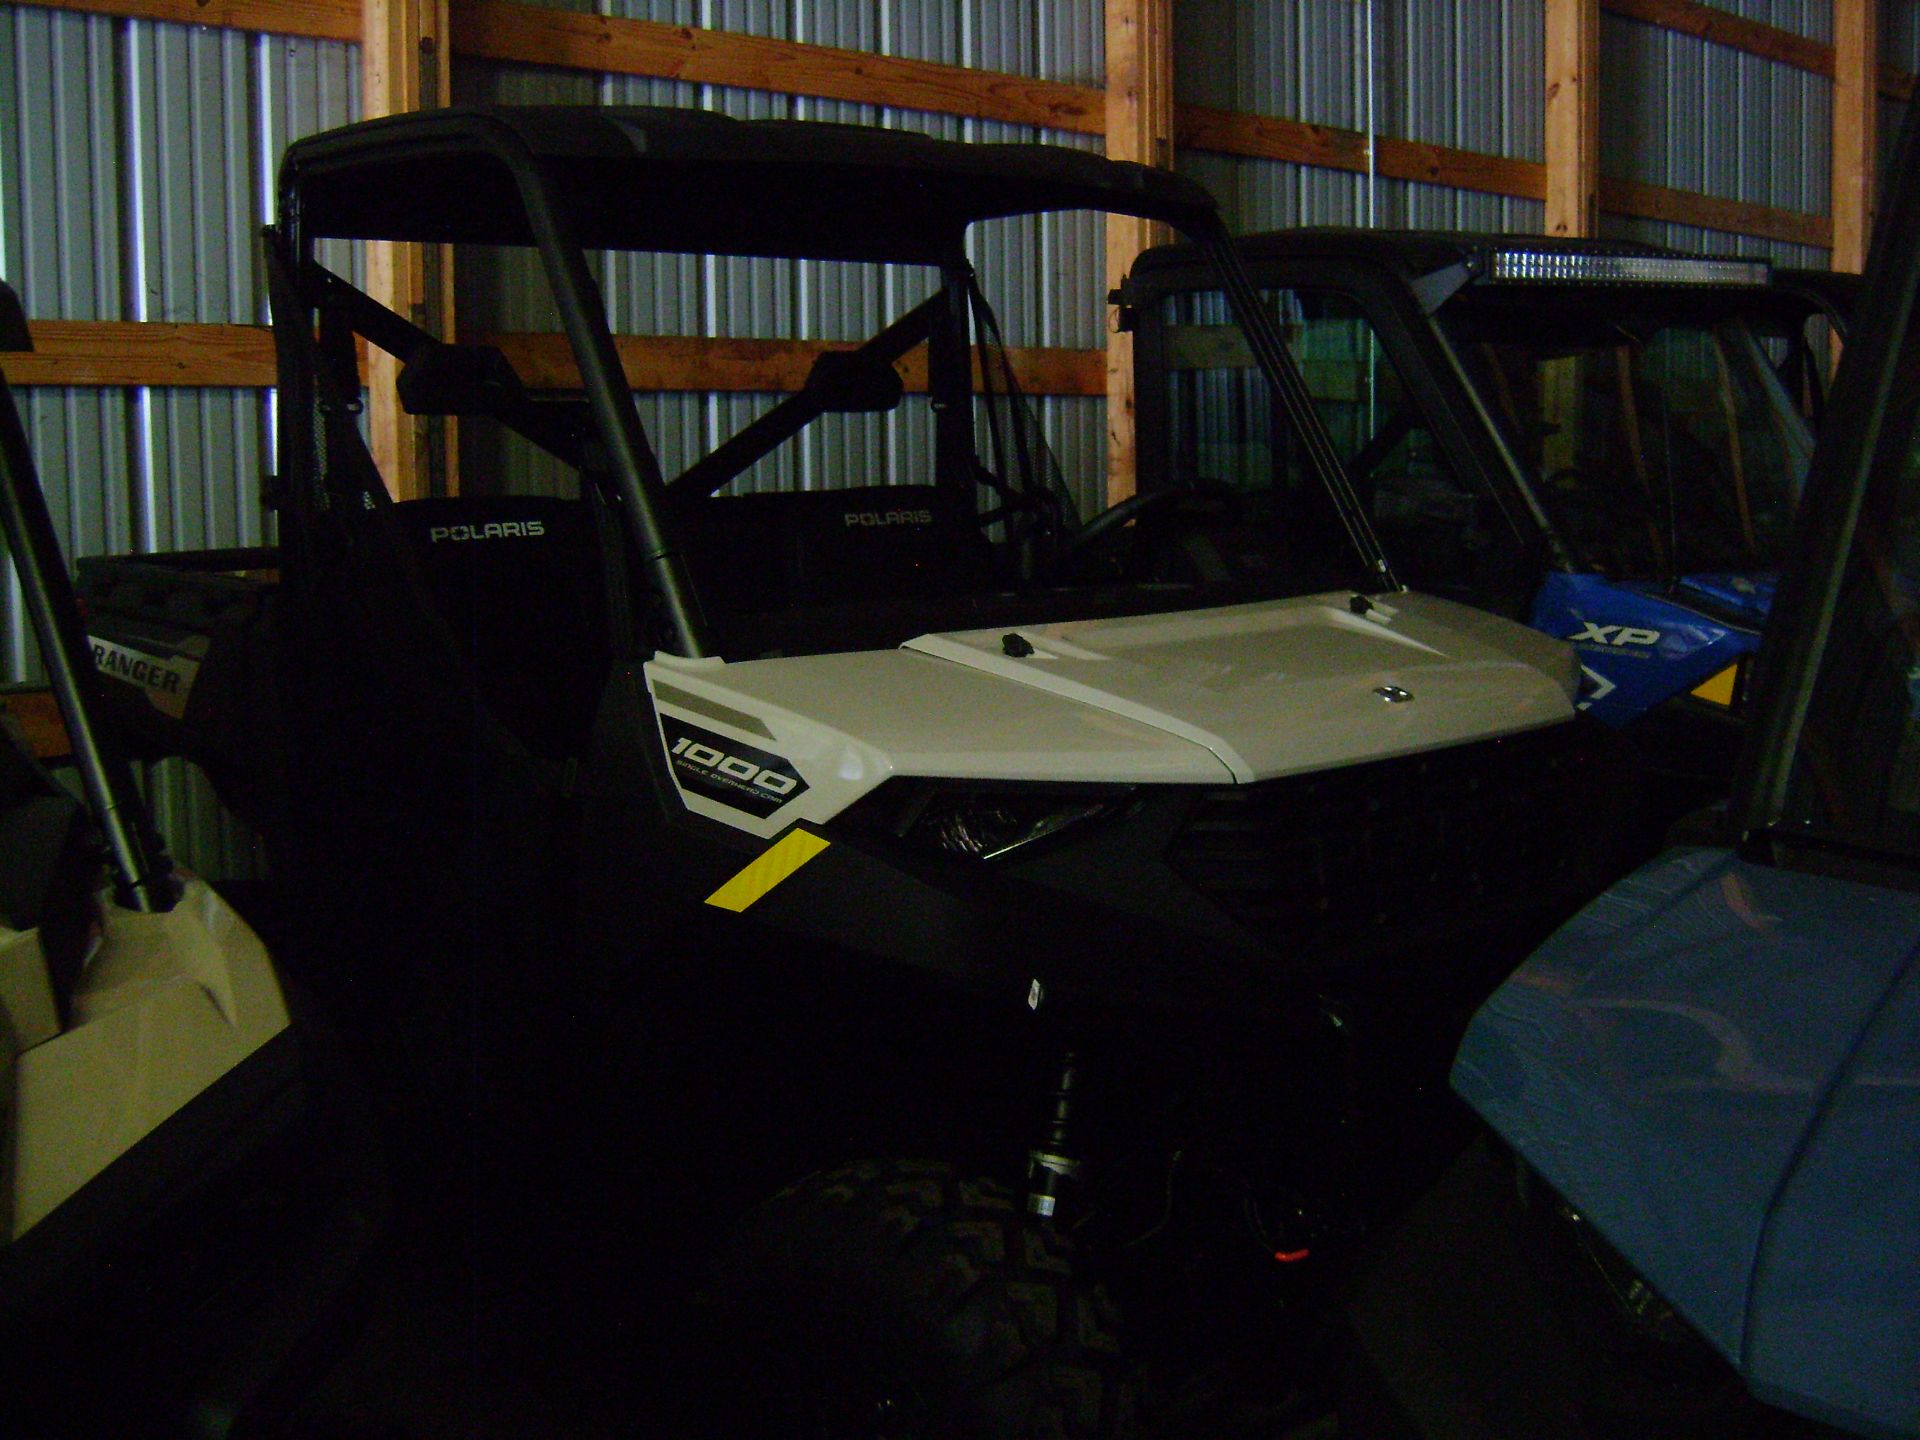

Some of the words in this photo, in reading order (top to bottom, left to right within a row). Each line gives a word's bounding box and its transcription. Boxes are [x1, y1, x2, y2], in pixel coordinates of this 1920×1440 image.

[844, 509, 933, 528] POLARIS
[430, 520, 545, 543] POLARIS
[1567, 621, 1661, 646] XP
[94, 643, 180, 693] RANGER
[671, 737, 798, 794] 1000
